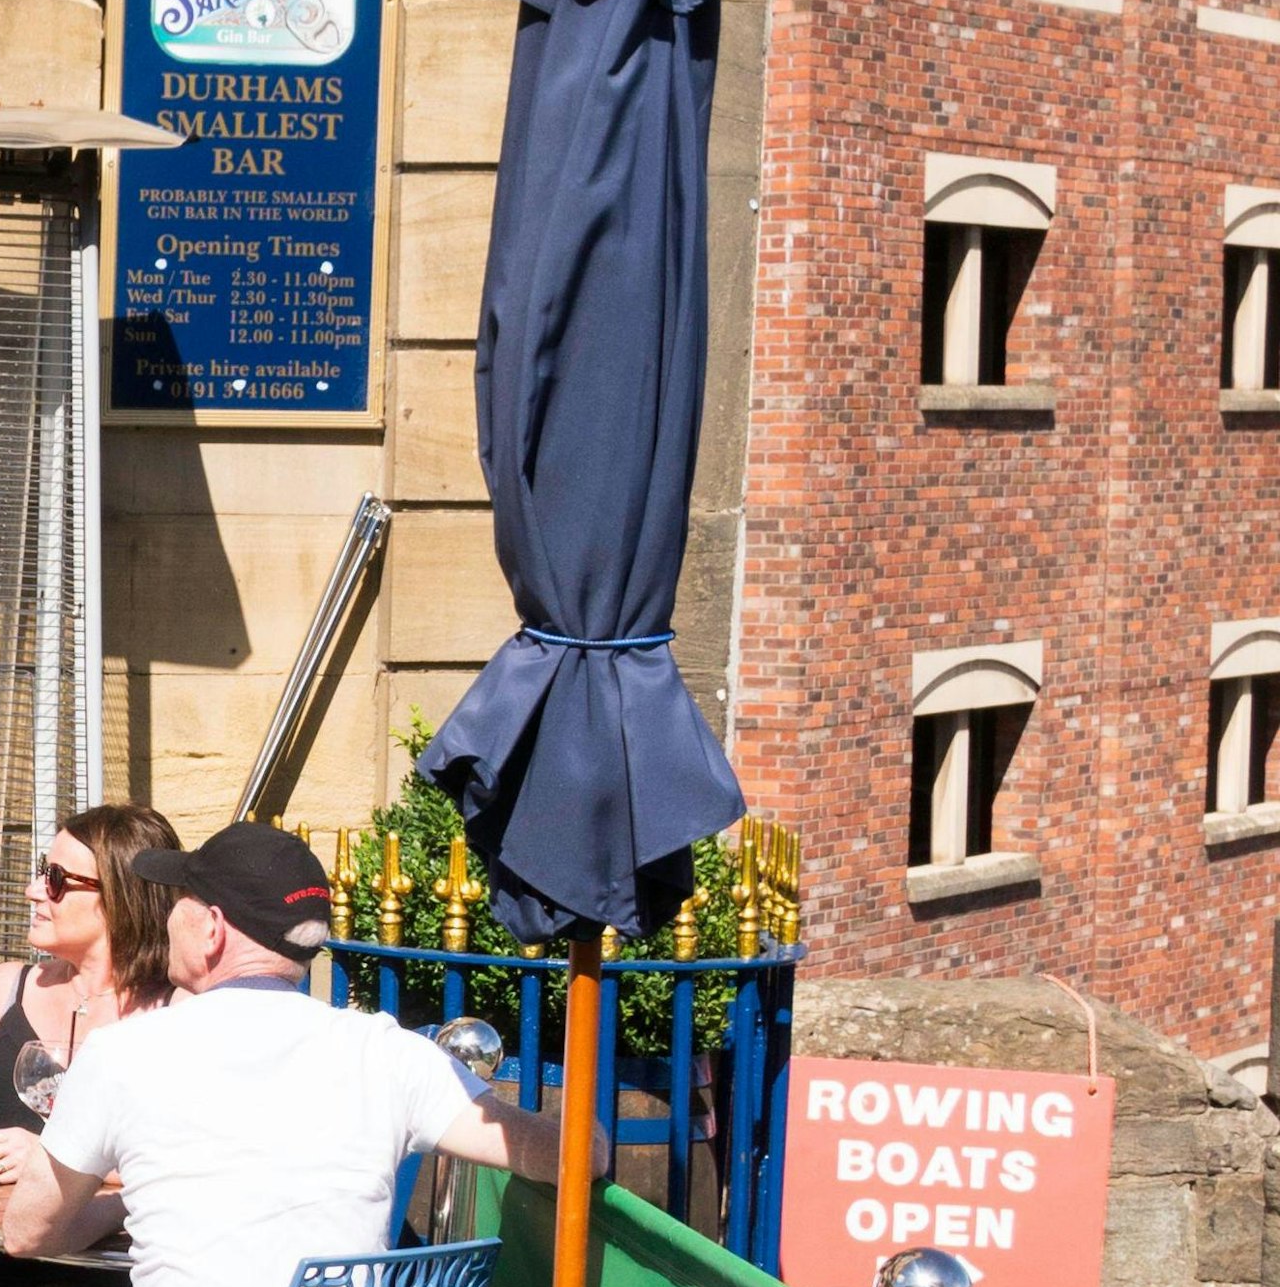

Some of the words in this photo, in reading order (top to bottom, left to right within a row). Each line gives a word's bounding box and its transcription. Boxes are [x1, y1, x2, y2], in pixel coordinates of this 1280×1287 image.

[216, 28, 243, 43] Gin
[247, 29, 273, 44] Bar
[161, 72, 343, 104] DURHAMS
[156, 109, 343, 141] SMALLEST
[211, 147, 286, 176] BAR
[138, 188, 228, 204] PROBABLY
[232, 190, 268, 205] THE
[271, 191, 357, 206] SMALLEST
[147, 205, 180, 220] GIN
[184, 206, 218, 221] BAR
[223, 207, 243, 220] IN
[247, 207, 282, 222] THE
[287, 208, 349, 223] WORLD
[156, 234, 261, 262] Opening
[268, 235, 341, 258] Times
[126, 269, 165, 285] Mon
[180, 270, 211, 285] Tue
[231, 272, 267, 287] 2.30
[284, 272, 355, 291] 11.00pm
[126, 289, 163, 305] Wed
[230, 290, 266, 305] 2.30
[283, 291, 354, 311] 11.30pm
[126, 308, 150, 323] Fri
[164, 308, 190, 324] Sat
[230, 310, 274, 325] 12.00
[291, 310, 361, 330] 11.30pm
[124, 327, 157, 342] Sun
[229, 329, 274, 344] 12.00
[290, 329, 361, 349] 11.00pm
[136, 358, 204, 376] Private
[210, 359, 250, 377] hire
[255, 360, 341, 378] available
[171, 381, 215, 399] 0191
[806, 1078, 1075, 1138] ROWING
[836, 1138, 1037, 1193] BOATS
[845, 1198, 1016, 1250] OPEN
